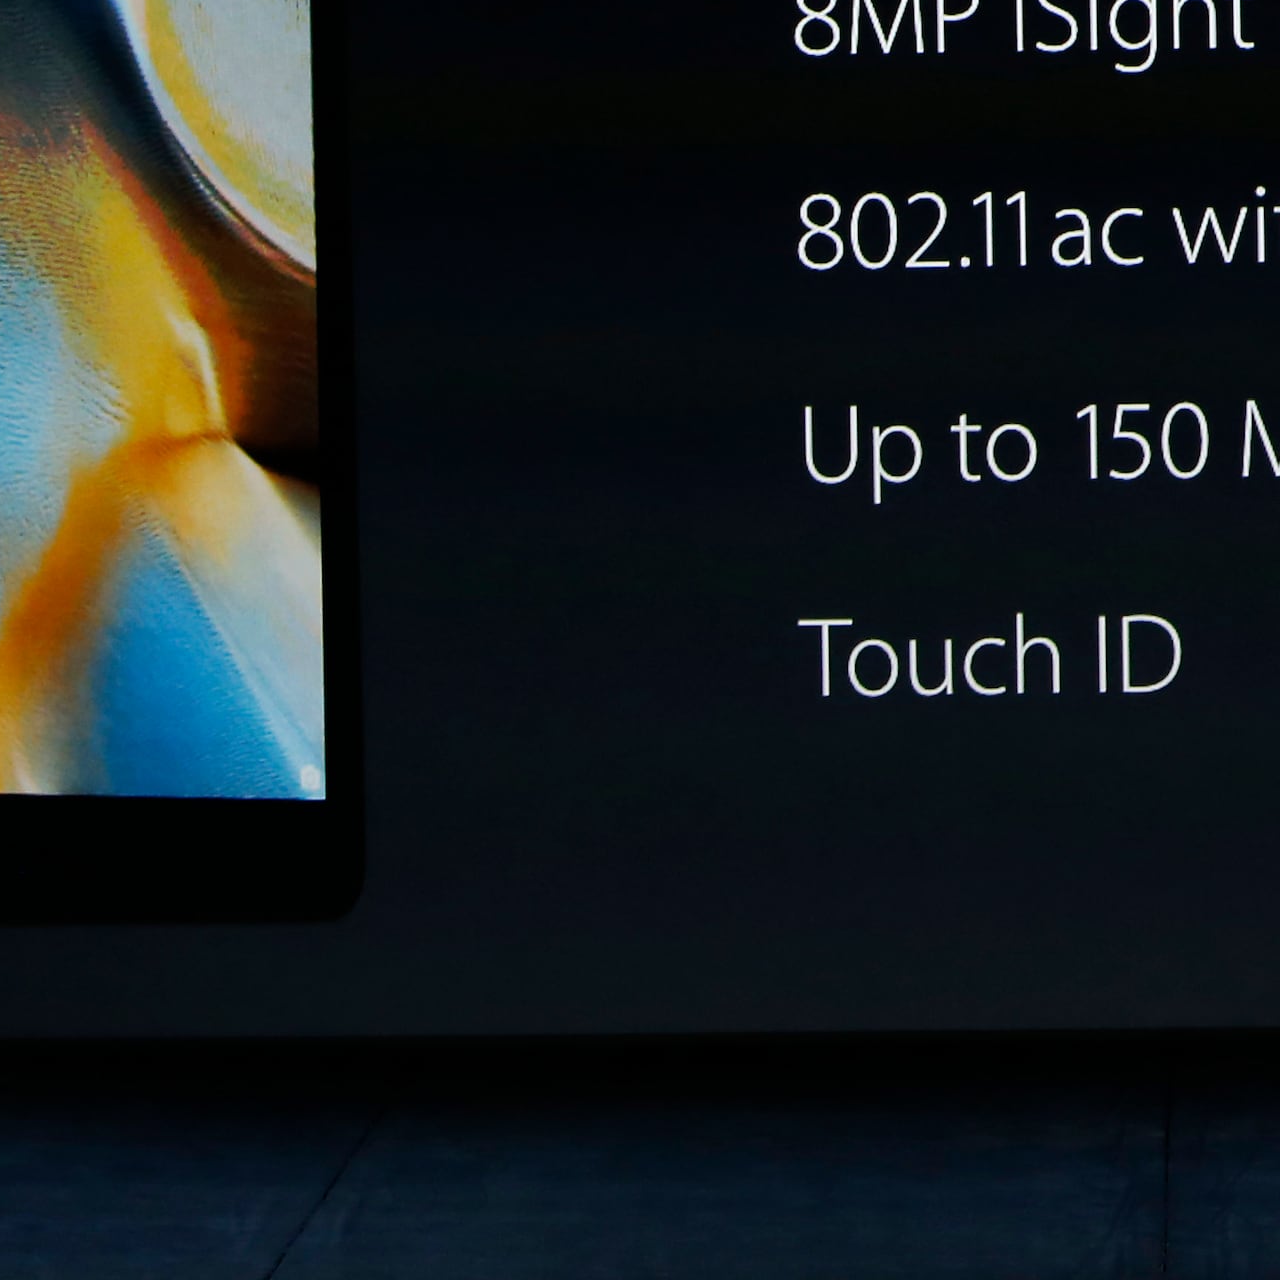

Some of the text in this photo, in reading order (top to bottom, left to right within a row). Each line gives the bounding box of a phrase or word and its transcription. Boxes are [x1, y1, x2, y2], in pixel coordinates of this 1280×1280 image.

[804, 404, 923, 505] Up
[949, 413, 1038, 483] to
[1076, 401, 1210, 481] 150
[797, 612, 1182, 698] Touch ID
